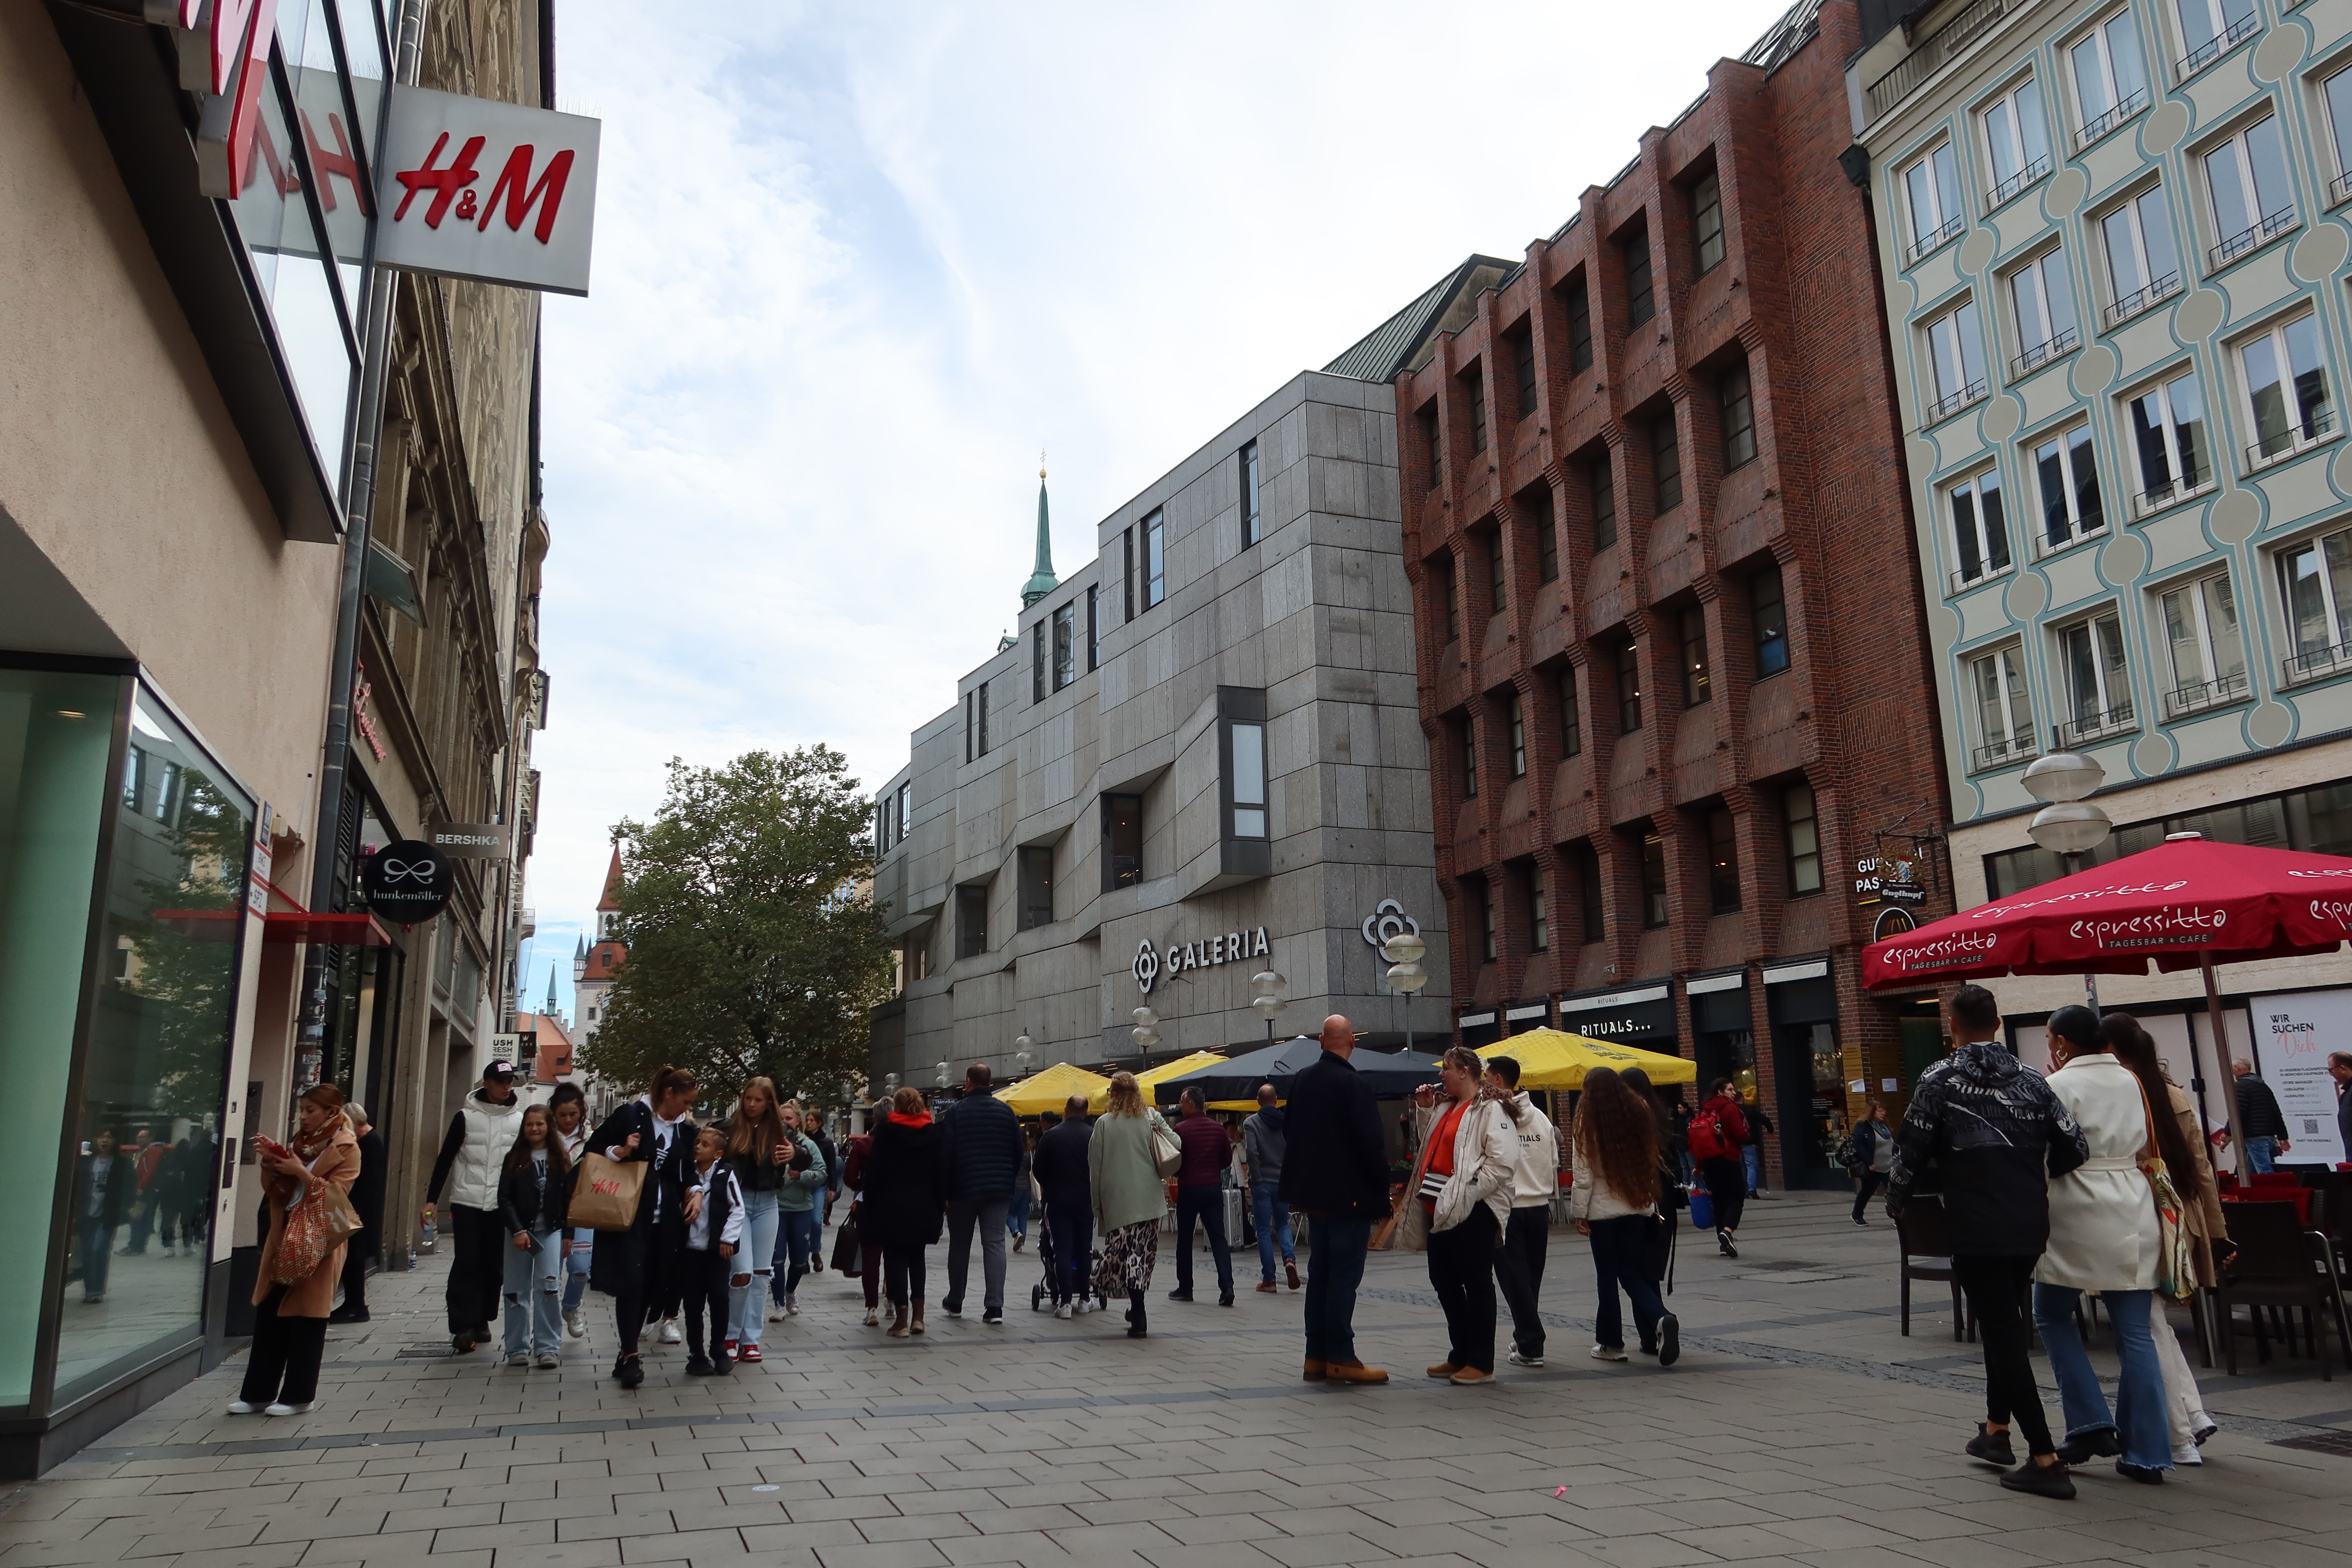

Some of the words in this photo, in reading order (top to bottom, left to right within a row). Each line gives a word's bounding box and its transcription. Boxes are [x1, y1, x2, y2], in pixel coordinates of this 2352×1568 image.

[394, 131, 575, 245] H&M
[435, 834, 500, 846] BERSHKA
[374, 889, 443, 901] hunkemöller
[1882, 888, 1924, 899] Guglhupf
[1972, 880, 2188, 918] espressitto
[2070, 906, 2227, 948] espressitto
[2109, 937, 2164, 948] TAGESBAR
[2179, 933, 2208, 944] CAFÉ
[1167, 925, 1271, 974] GALERIA
[1883, 931, 1997, 971] espressitto
[1911, 959, 1950, 970] TAGESBAR
[1961, 955, 1982, 964] CAFÉ
[2269, 1014, 2291, 1023] WIR
[1581, 1019, 1651, 1037] RITUALS...
[2272, 1022, 2315, 1034] SUCHEN
